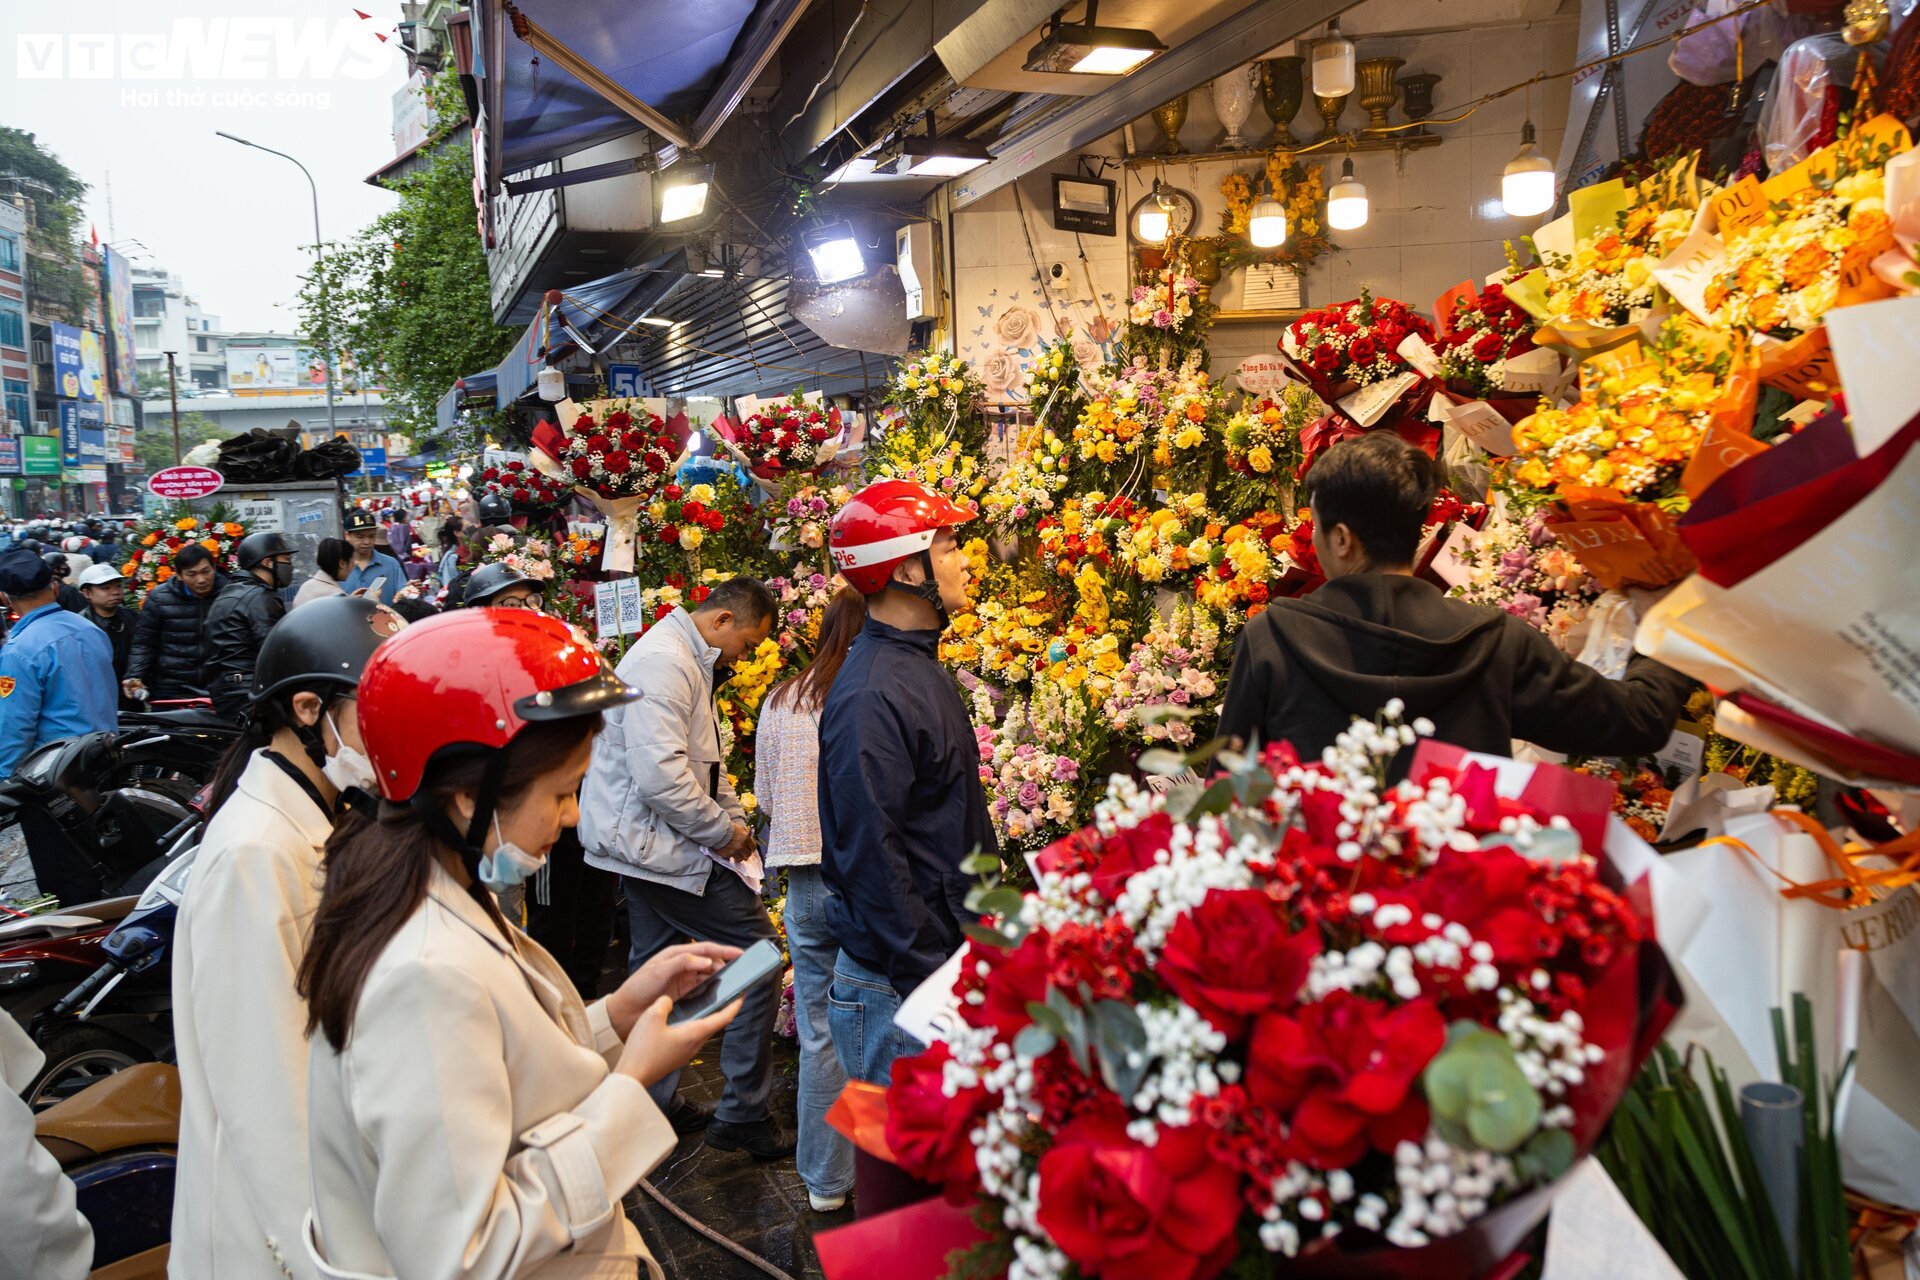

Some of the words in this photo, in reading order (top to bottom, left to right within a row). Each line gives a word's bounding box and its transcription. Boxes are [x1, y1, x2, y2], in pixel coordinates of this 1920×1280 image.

[1577, 164, 1605, 187] ALU
[67, 408, 78, 448] KidsPlaza
[834, 550, 857, 567] Pie
